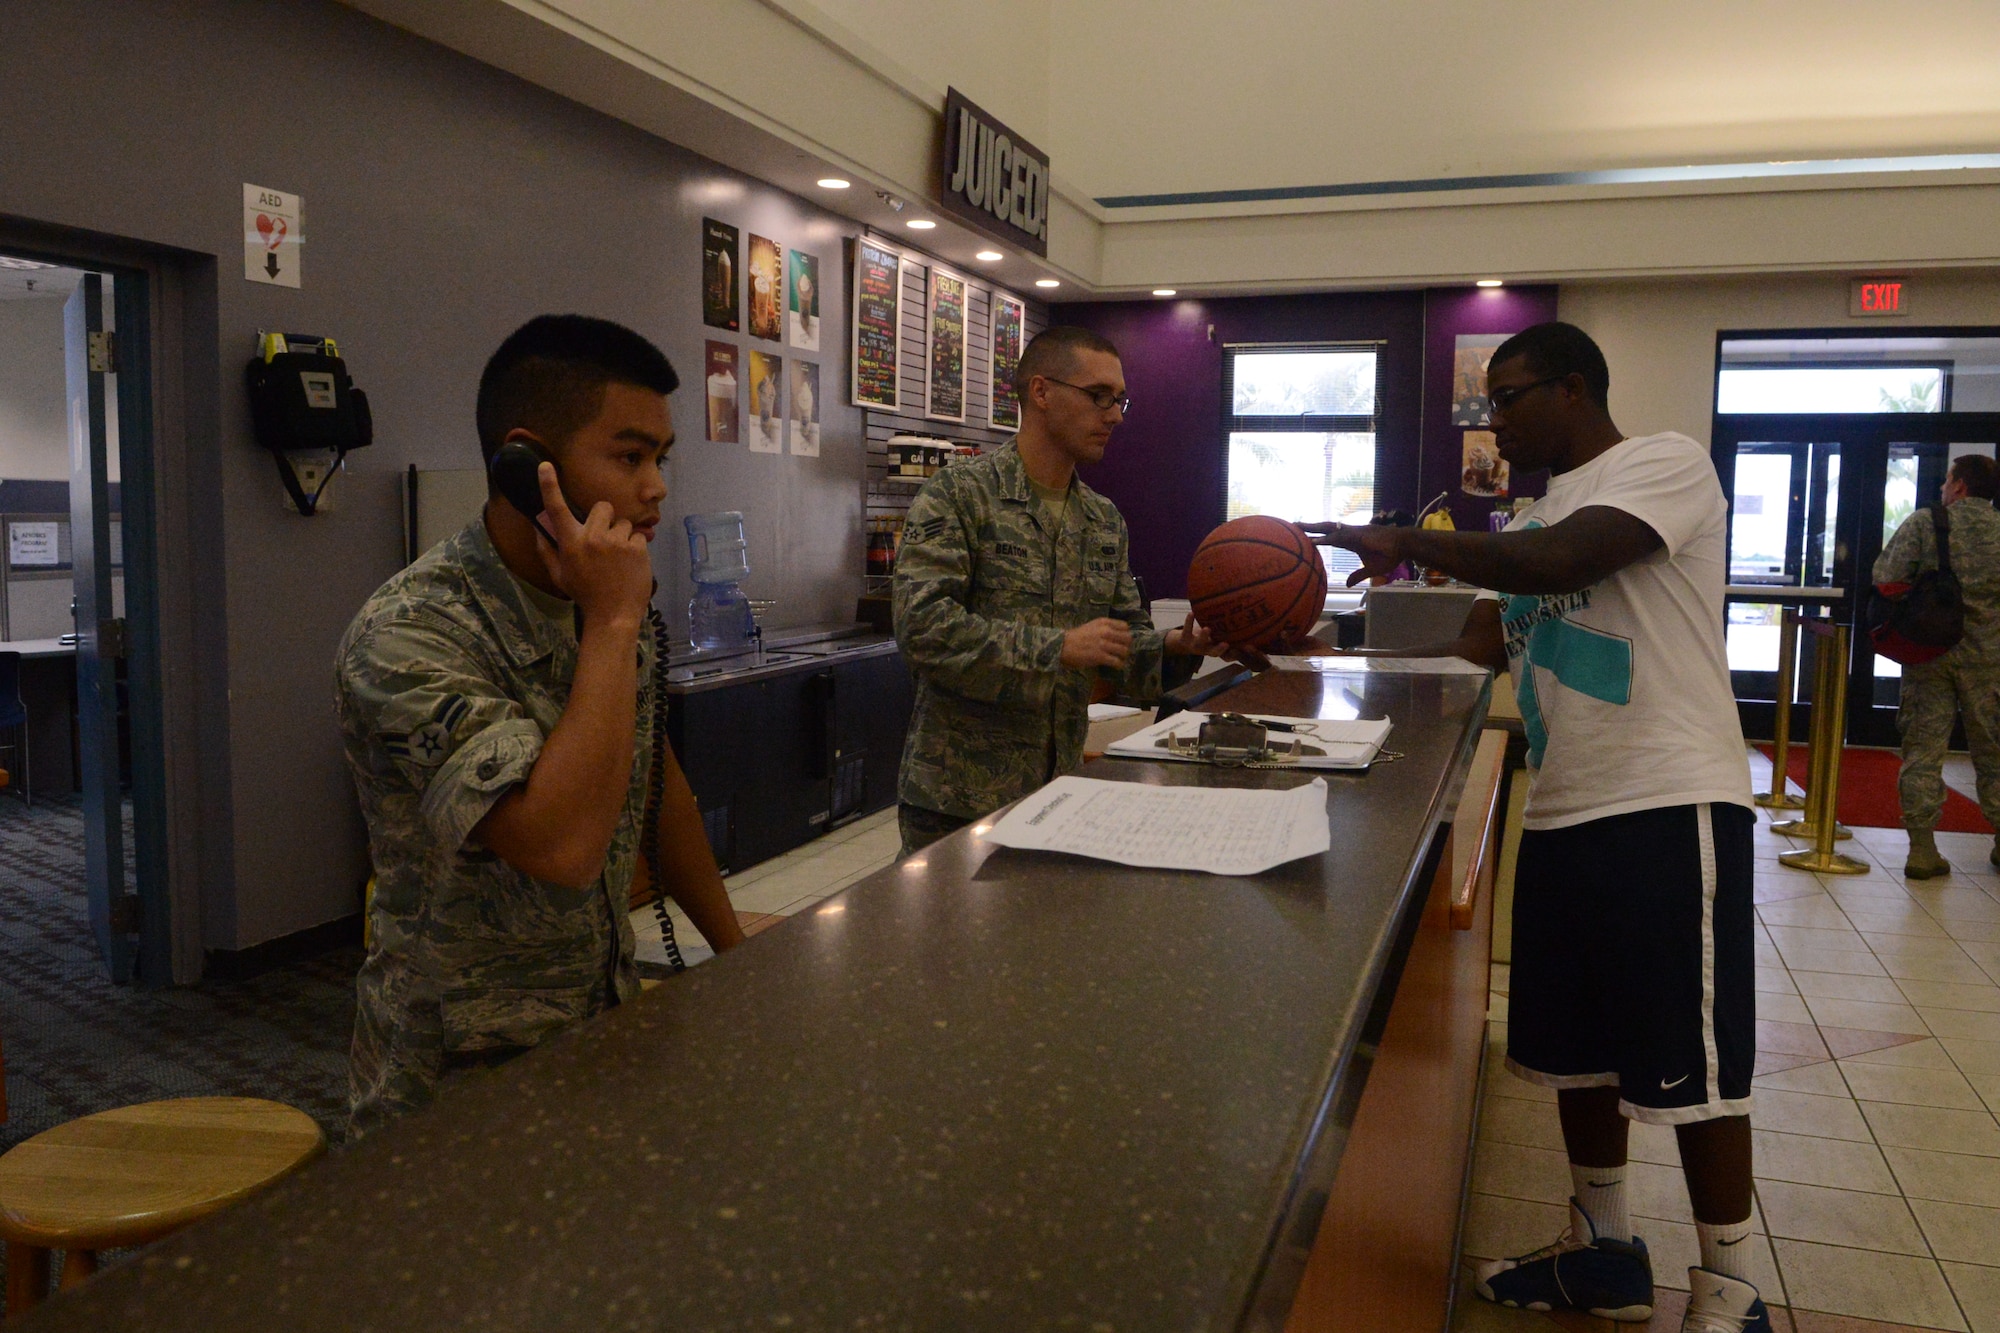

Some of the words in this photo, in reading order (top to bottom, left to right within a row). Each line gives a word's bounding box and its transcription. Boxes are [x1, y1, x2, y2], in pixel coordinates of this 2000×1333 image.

[952, 107, 1049, 242] JUICED!
[259, 192, 282, 207] AED
[1862, 283, 1902, 311] EXIT
[996, 543, 1028, 558] BEATON
